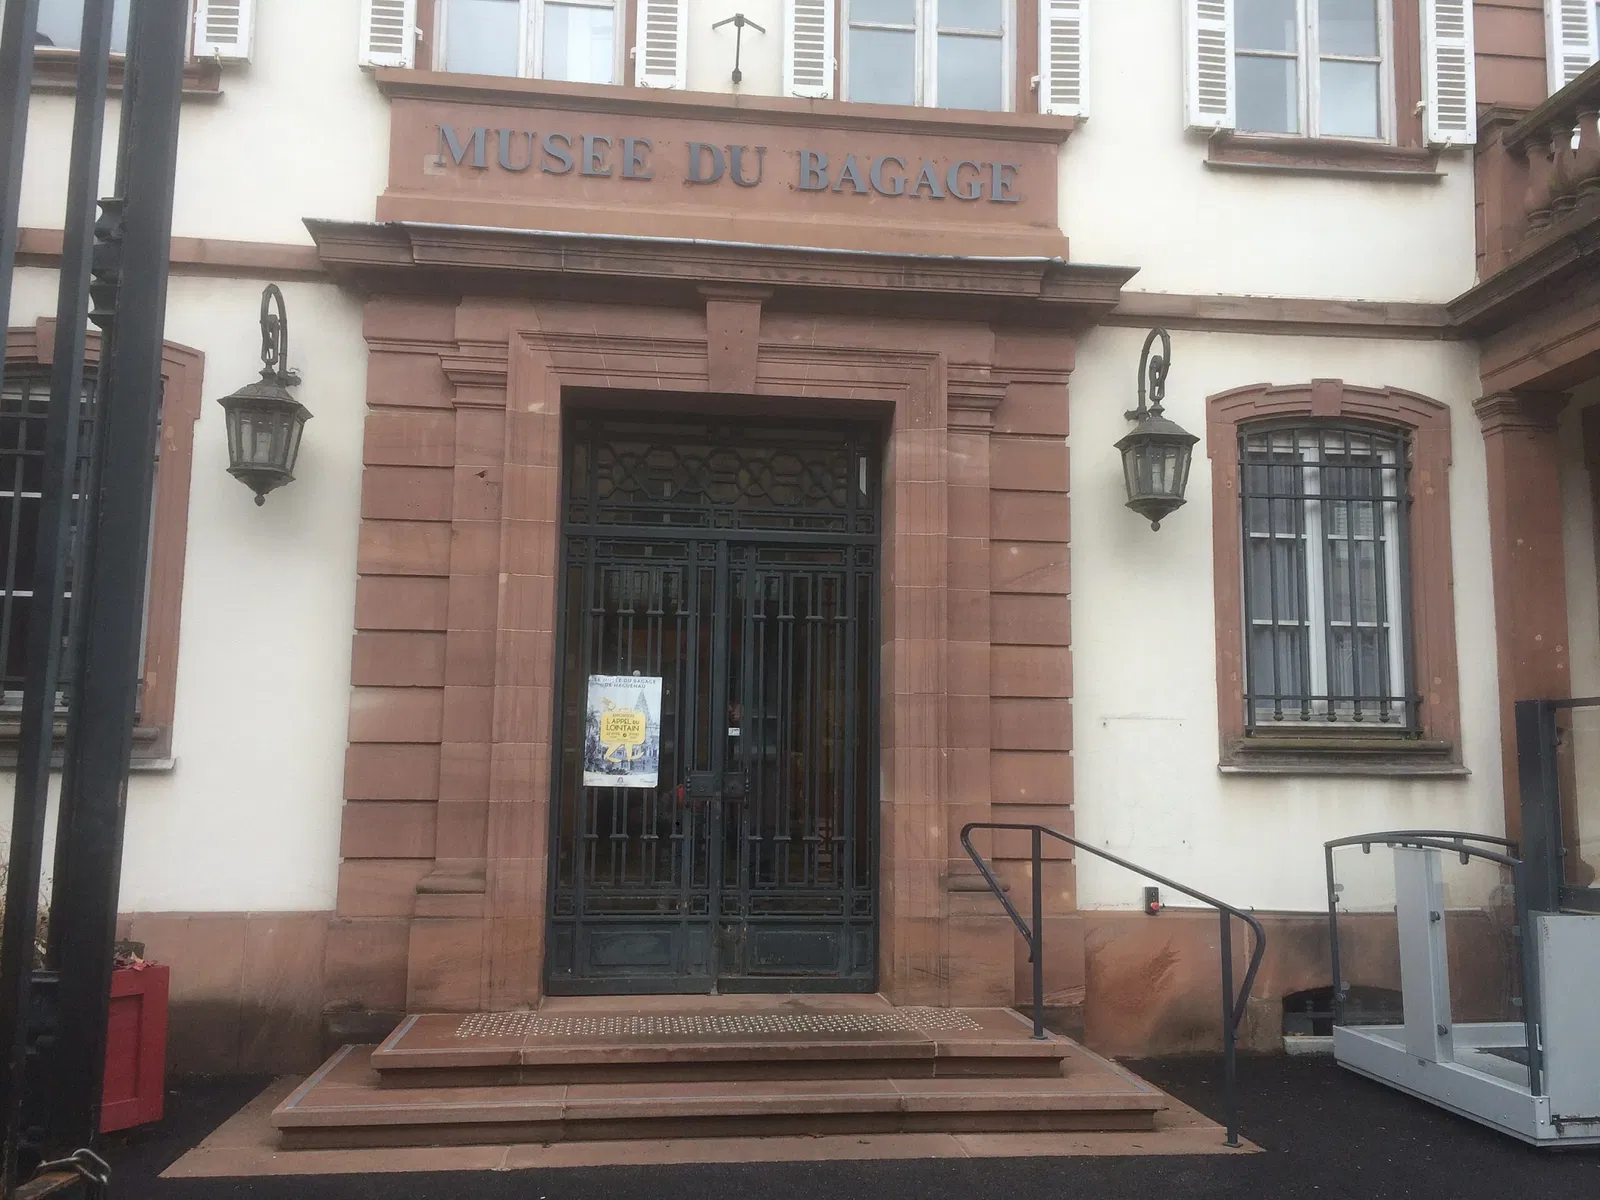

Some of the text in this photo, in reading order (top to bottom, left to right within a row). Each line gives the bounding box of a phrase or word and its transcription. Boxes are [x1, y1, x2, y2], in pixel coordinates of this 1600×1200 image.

[436, 123, 1022, 202] MUSEE DU BAGAGE
